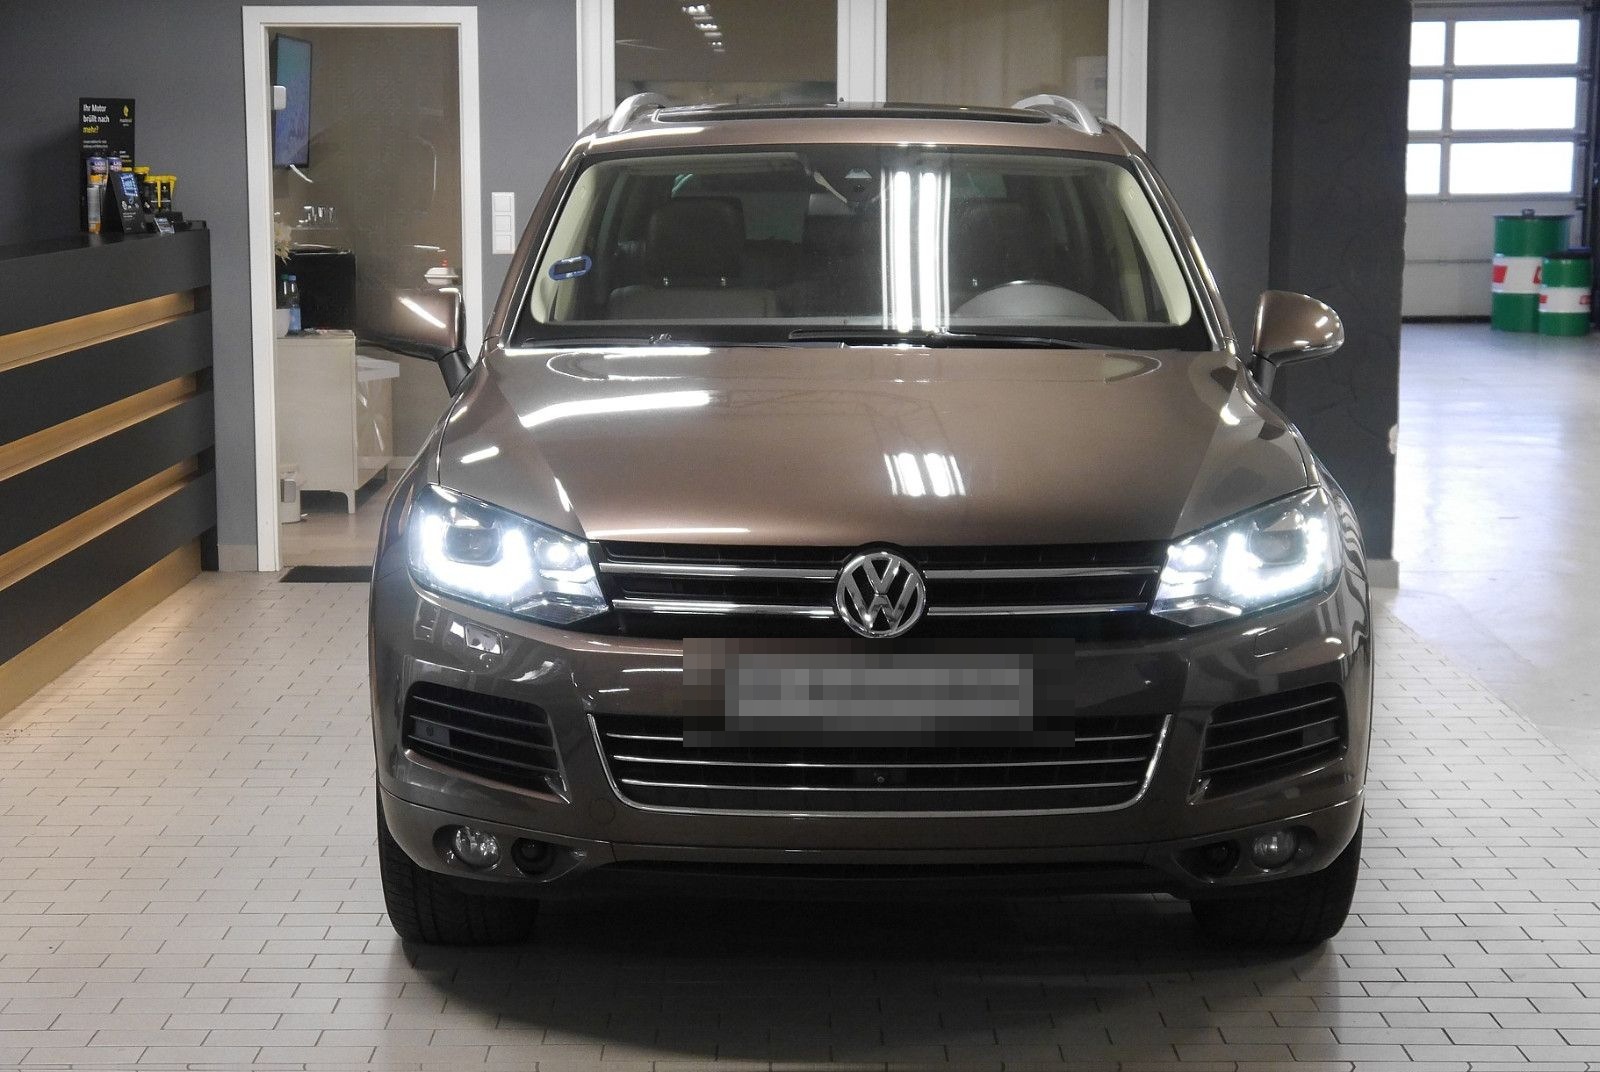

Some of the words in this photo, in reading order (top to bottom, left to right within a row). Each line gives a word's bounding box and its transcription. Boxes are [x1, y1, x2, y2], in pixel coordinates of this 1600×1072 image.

[83, 104, 91, 112] Ihr
[92, 104, 107, 112] Motor
[83, 115, 97, 123] brüllt
[98, 115, 110, 123] nach
[83, 125, 99, 133] mehr?
[838, 554, 924, 637] VW
